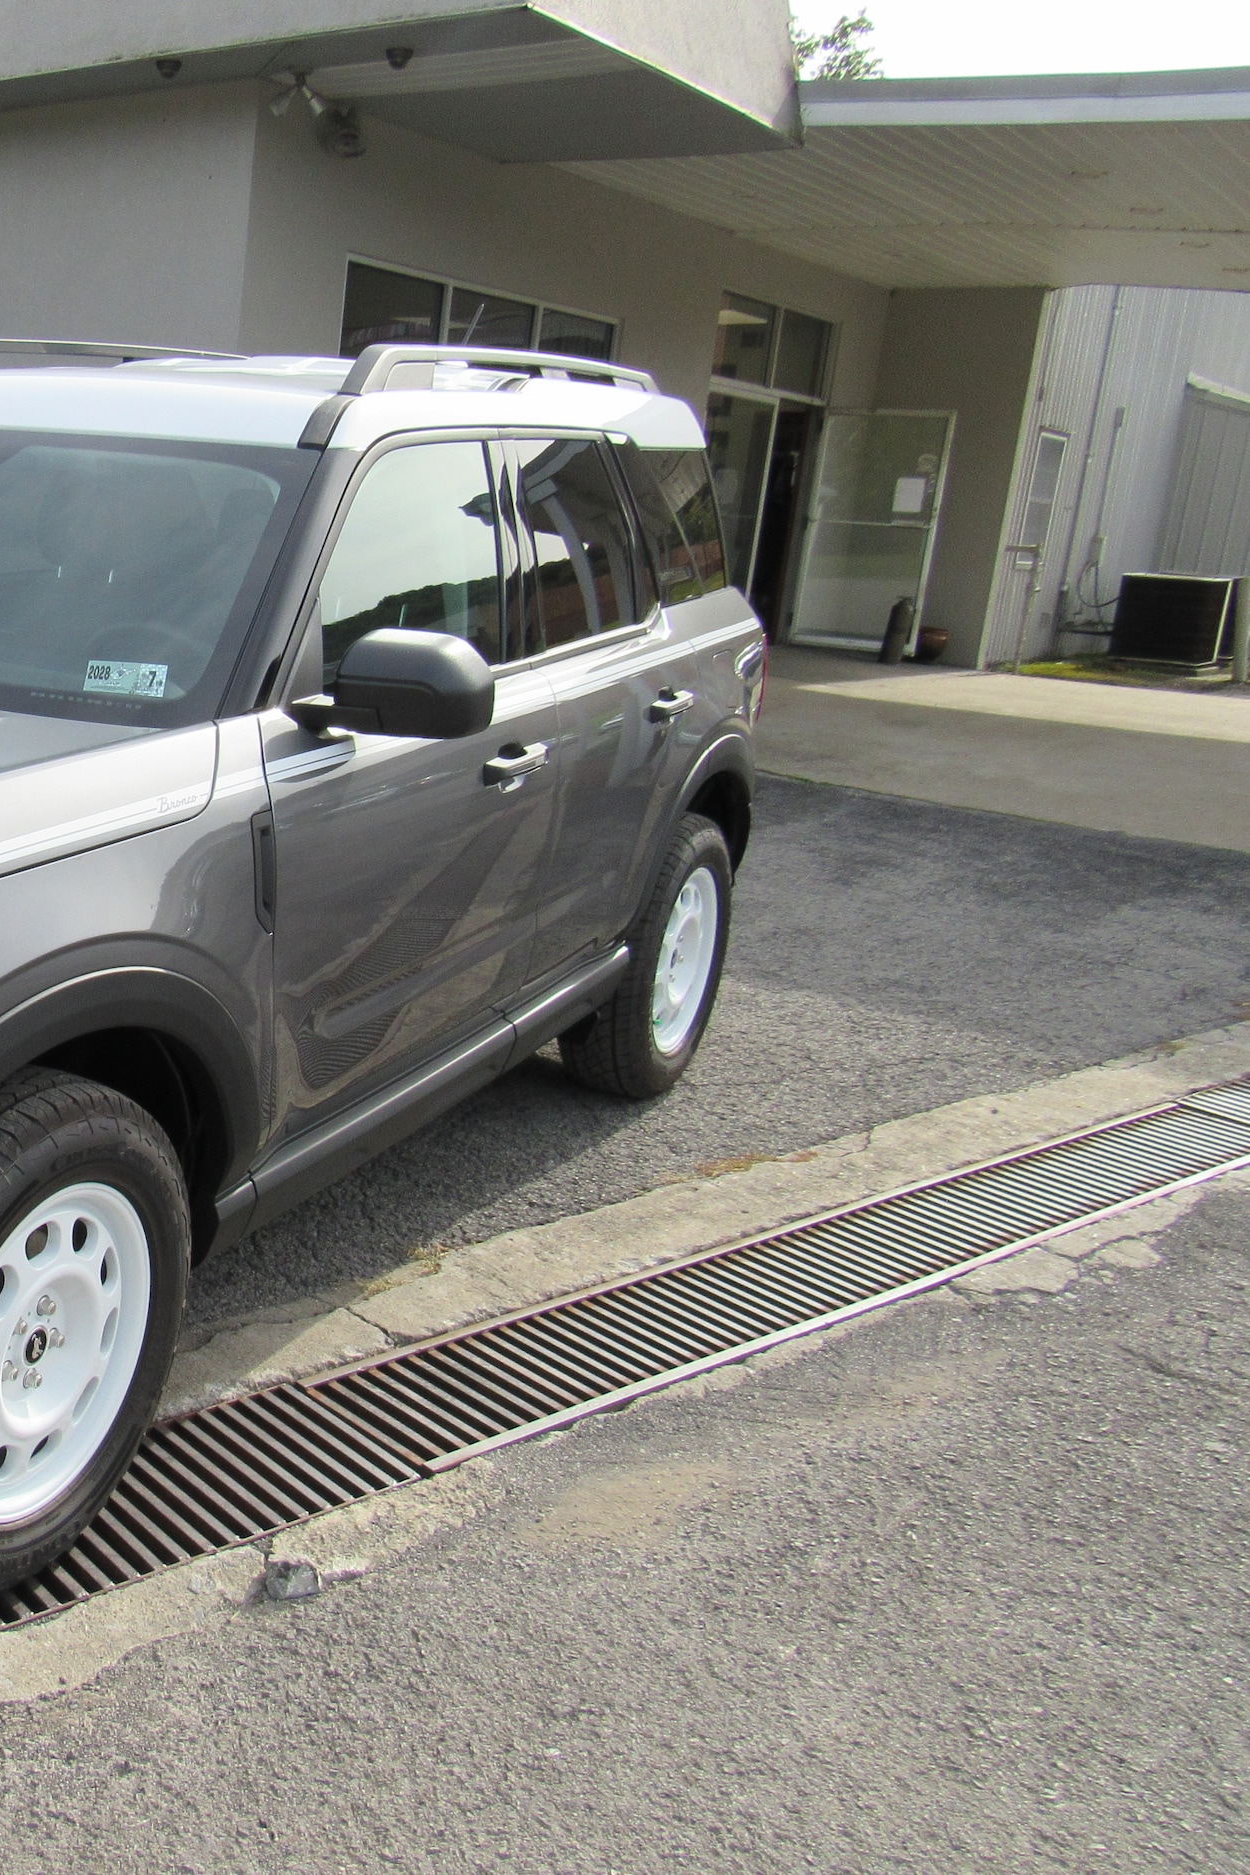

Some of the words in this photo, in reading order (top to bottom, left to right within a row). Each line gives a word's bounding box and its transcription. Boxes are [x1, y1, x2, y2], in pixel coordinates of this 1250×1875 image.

[87, 665, 111, 681] 2028
[148, 670, 157, 688] 7
[157, 795, 198, 814] Bronco
